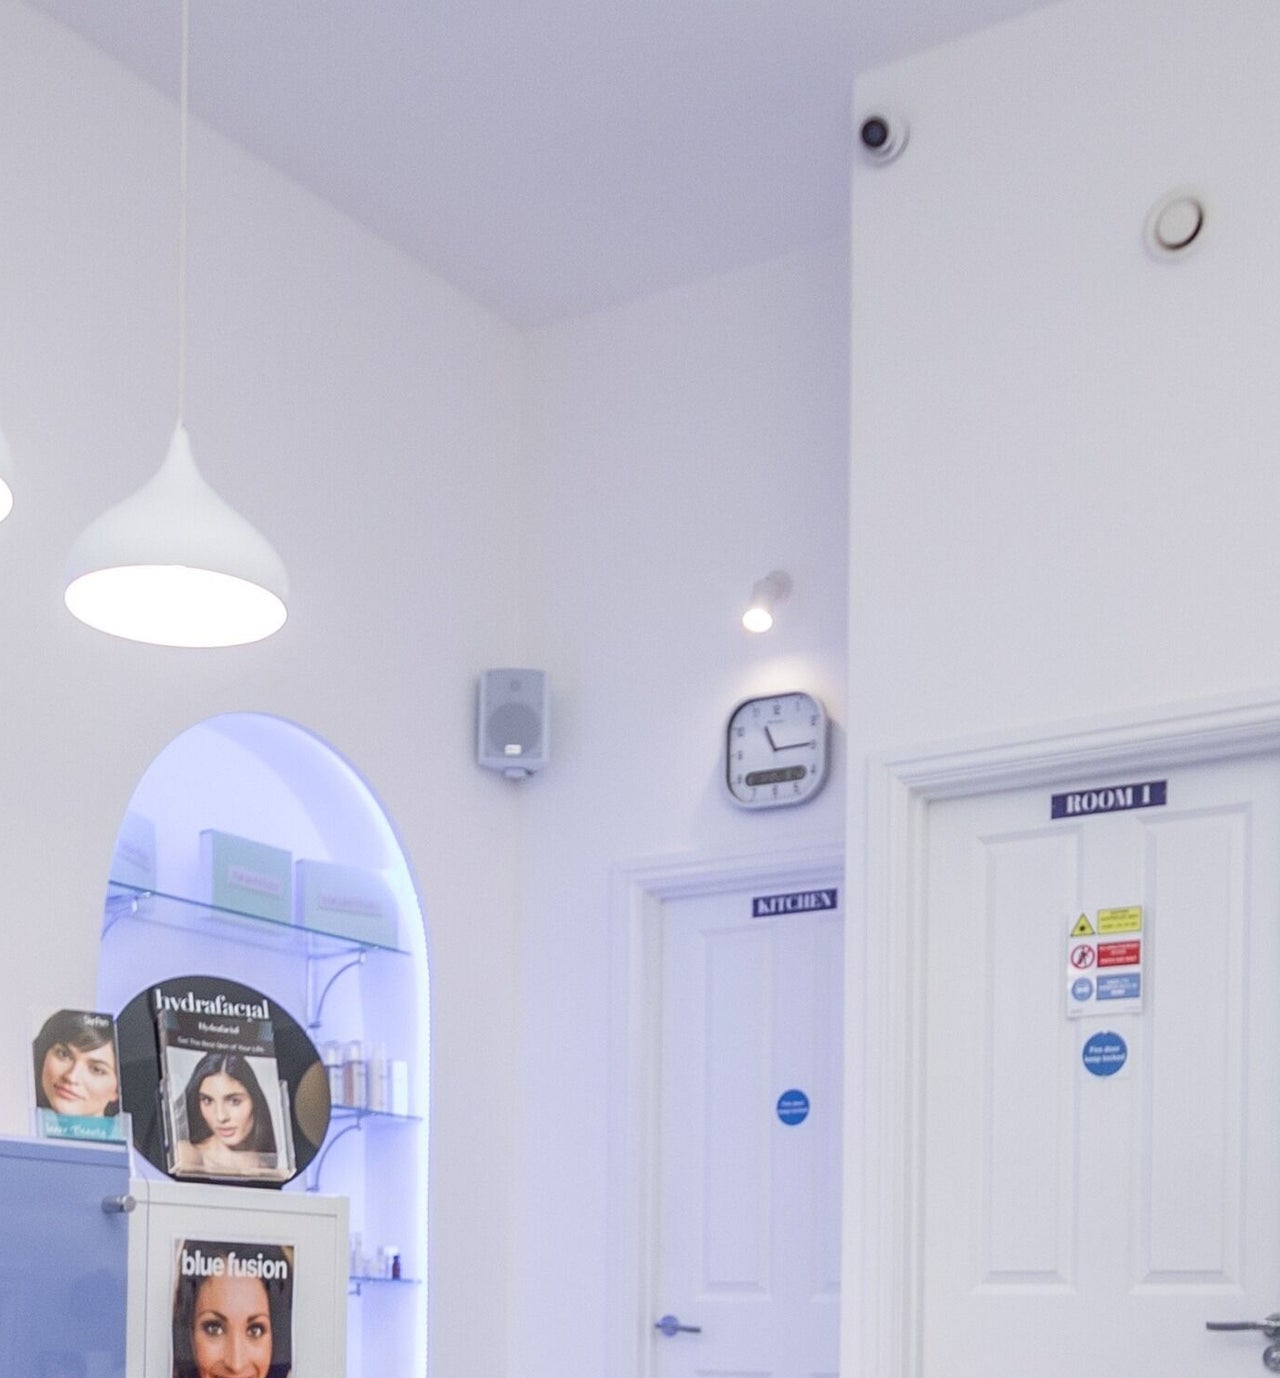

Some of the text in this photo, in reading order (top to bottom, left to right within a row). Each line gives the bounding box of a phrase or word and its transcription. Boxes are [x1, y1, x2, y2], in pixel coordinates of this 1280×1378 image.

[1066, 787, 1133, 814] ROOM
[758, 891, 831, 914] KITCHEN
[182, 1248, 288, 1279] blue fusion
